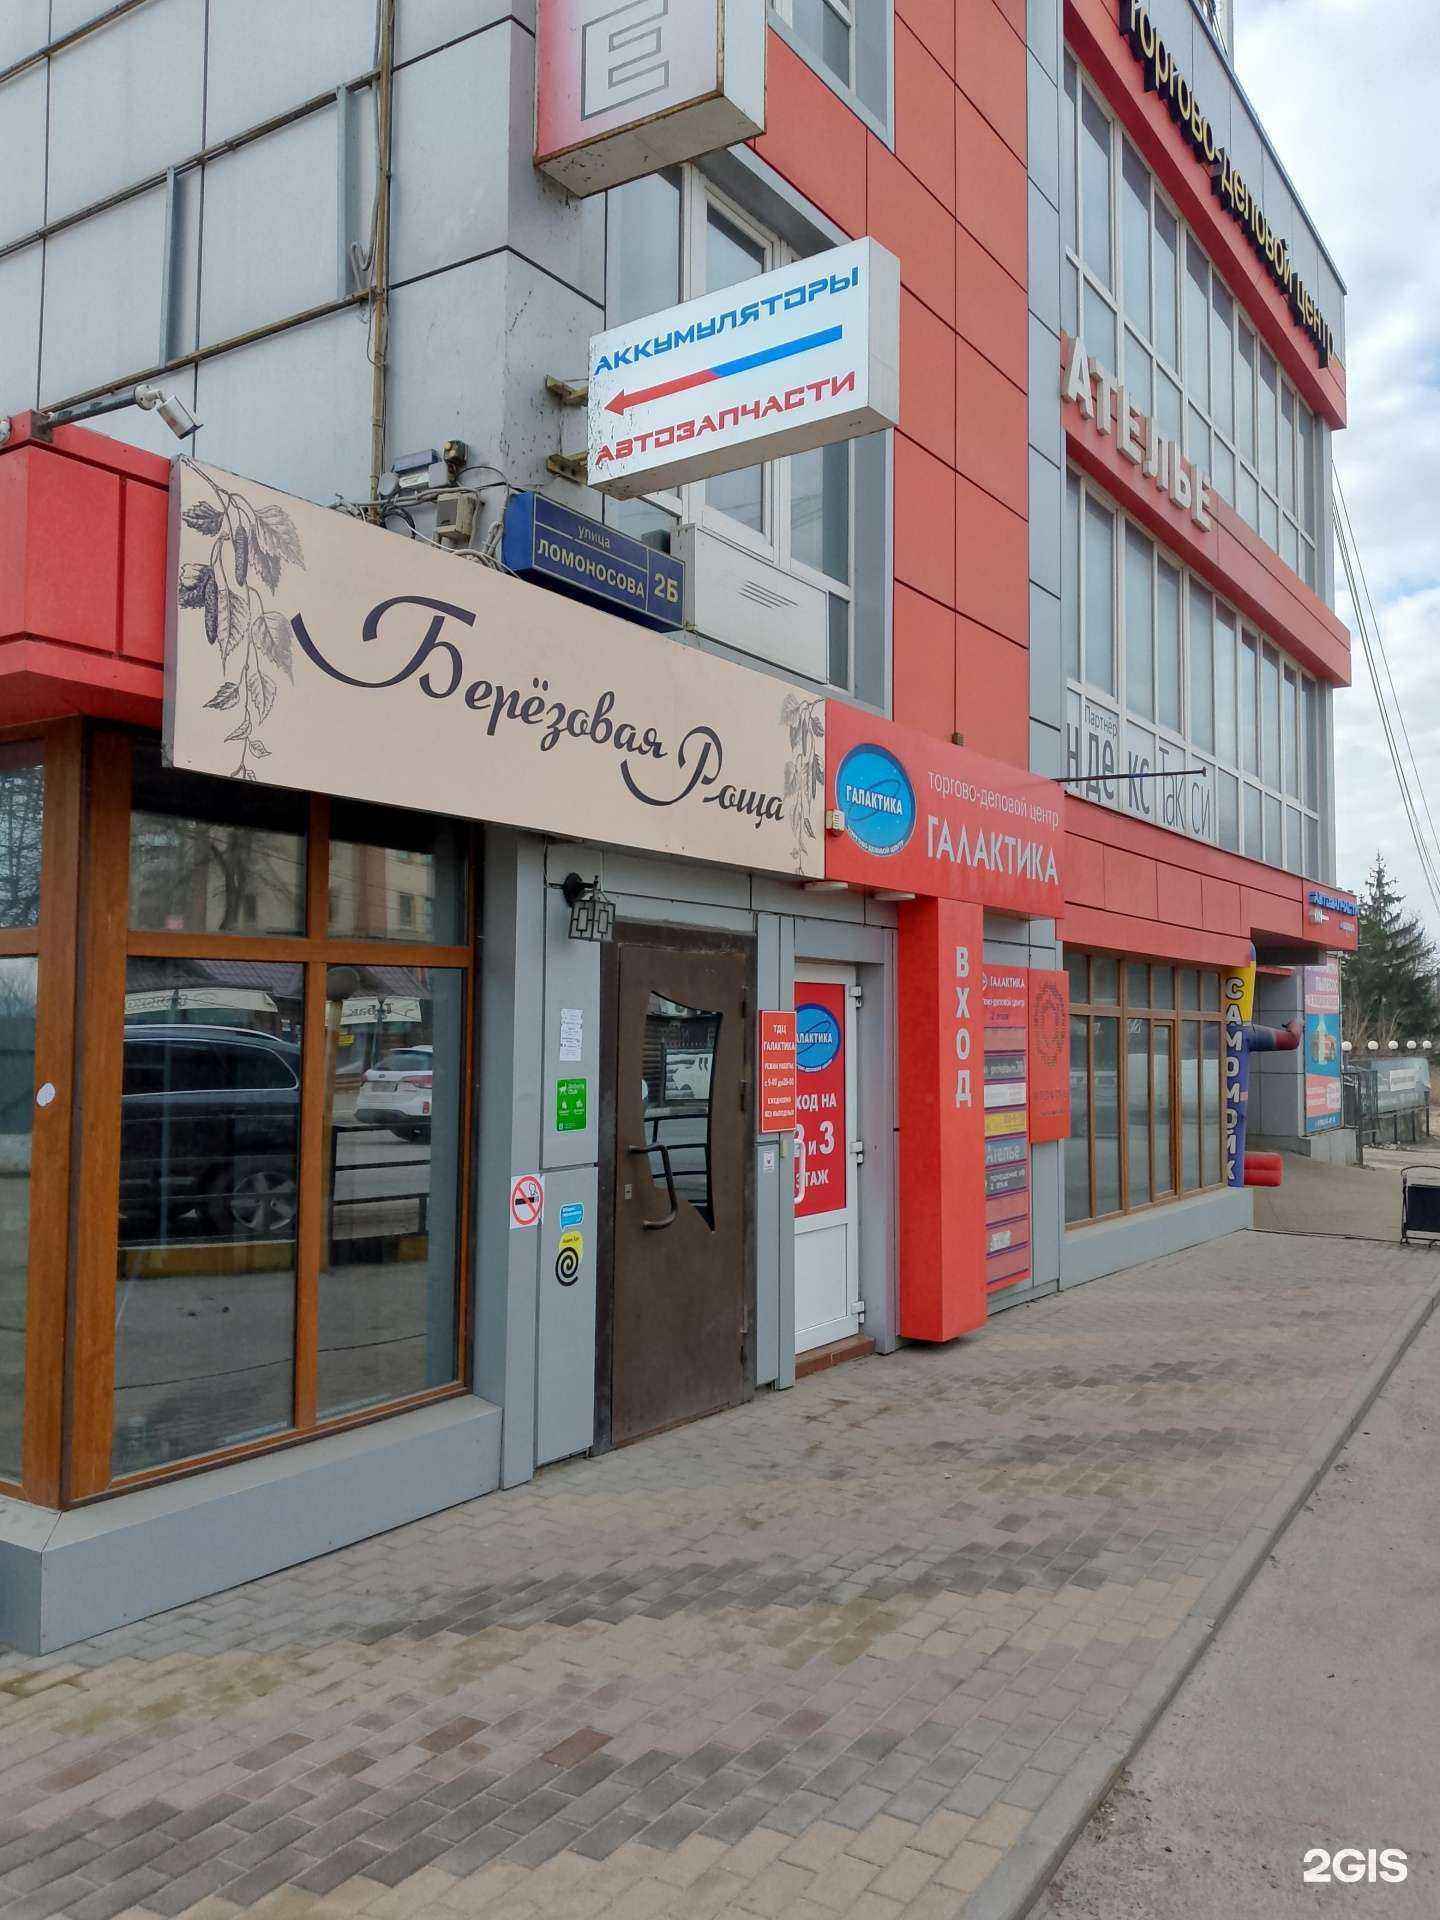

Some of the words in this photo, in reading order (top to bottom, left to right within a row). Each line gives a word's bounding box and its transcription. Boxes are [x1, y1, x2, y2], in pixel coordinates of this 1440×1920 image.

[594, 266, 859, 376] АККУМУЛЯТОРЫ
[595, 370, 856, 465] АВТОЗАПЧАСТИ
[1062, 335, 1213, 532] АТЕЛЬЕ
[578, 525, 610, 549] улица
[538, 539, 645, 598] ЛОМОНОСОВА
[654, 573, 679, 603] 2Б
[290, 595, 668, 752] Берёзовая
[619, 725, 785, 829] Роща
[846, 785, 903, 816] ГАЛАКТИКА
[927, 770, 1027, 816] торгово-деловой
[1029, 803, 1059, 832] центр
[927, 813, 1059, 886] ГАЛАКТИКА
[989, 975, 1025, 990] ГАЛАКТИКА
[763, 1041, 795, 1051] ГАЛАКТИКА
[773, 1024, 788, 1035] ТДЦ
[955, 946, 972, 1108] ВХОД
[821, 1093, 837, 1108] НА
[819, 1120, 835, 1155] 3
